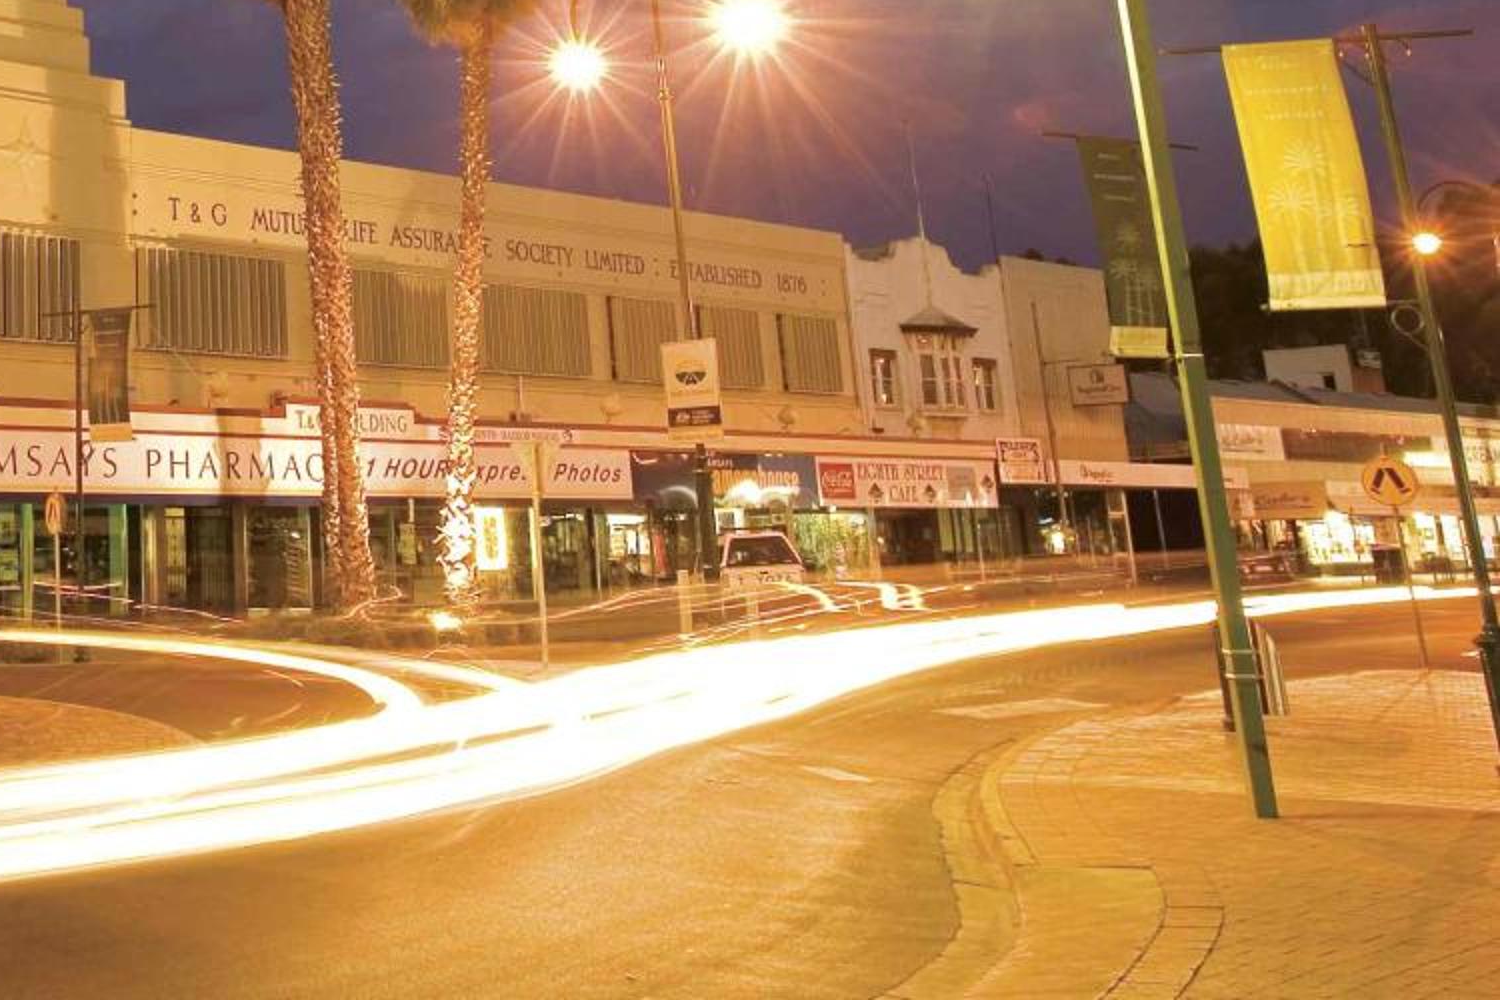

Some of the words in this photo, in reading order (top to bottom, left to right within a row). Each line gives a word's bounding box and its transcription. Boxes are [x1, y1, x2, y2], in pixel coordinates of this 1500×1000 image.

[250, 208, 308, 236] MUTU
[389, 225, 493, 258] ASSURAE
[504, 239, 573, 268] SOCIETY
[585, 250, 645, 276] LIMITED
[669, 259, 762, 289] ETABLISHED
[146, 448, 324, 483] PHARMAC
[383, 458, 450, 480] HOUR
[553, 462, 622, 483] Photos
